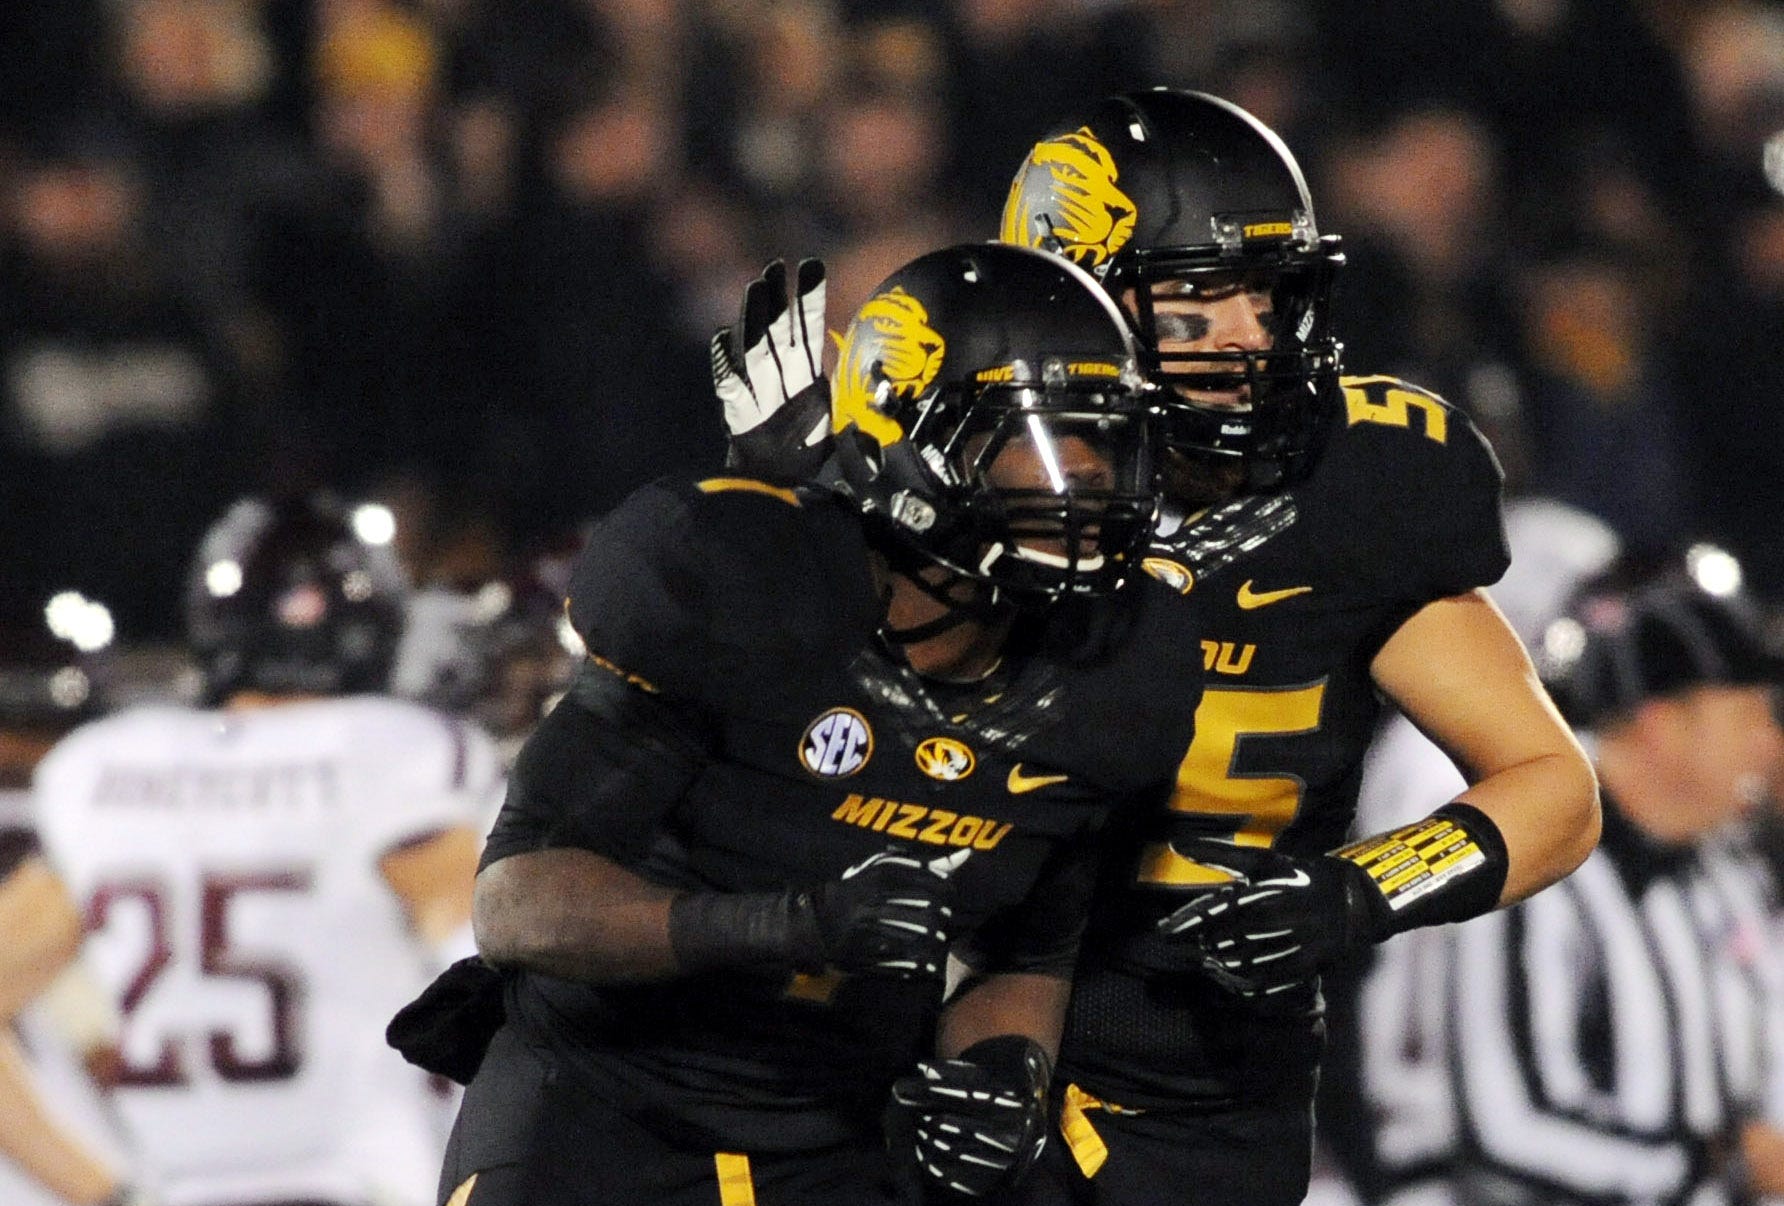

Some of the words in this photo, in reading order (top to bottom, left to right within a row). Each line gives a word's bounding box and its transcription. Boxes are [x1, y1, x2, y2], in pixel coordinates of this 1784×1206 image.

[804, 712, 868, 777] SEC
[1136, 683, 1325, 886] 5
[831, 793, 1014, 850] MIZZOU
[78, 868, 312, 1090] 25
